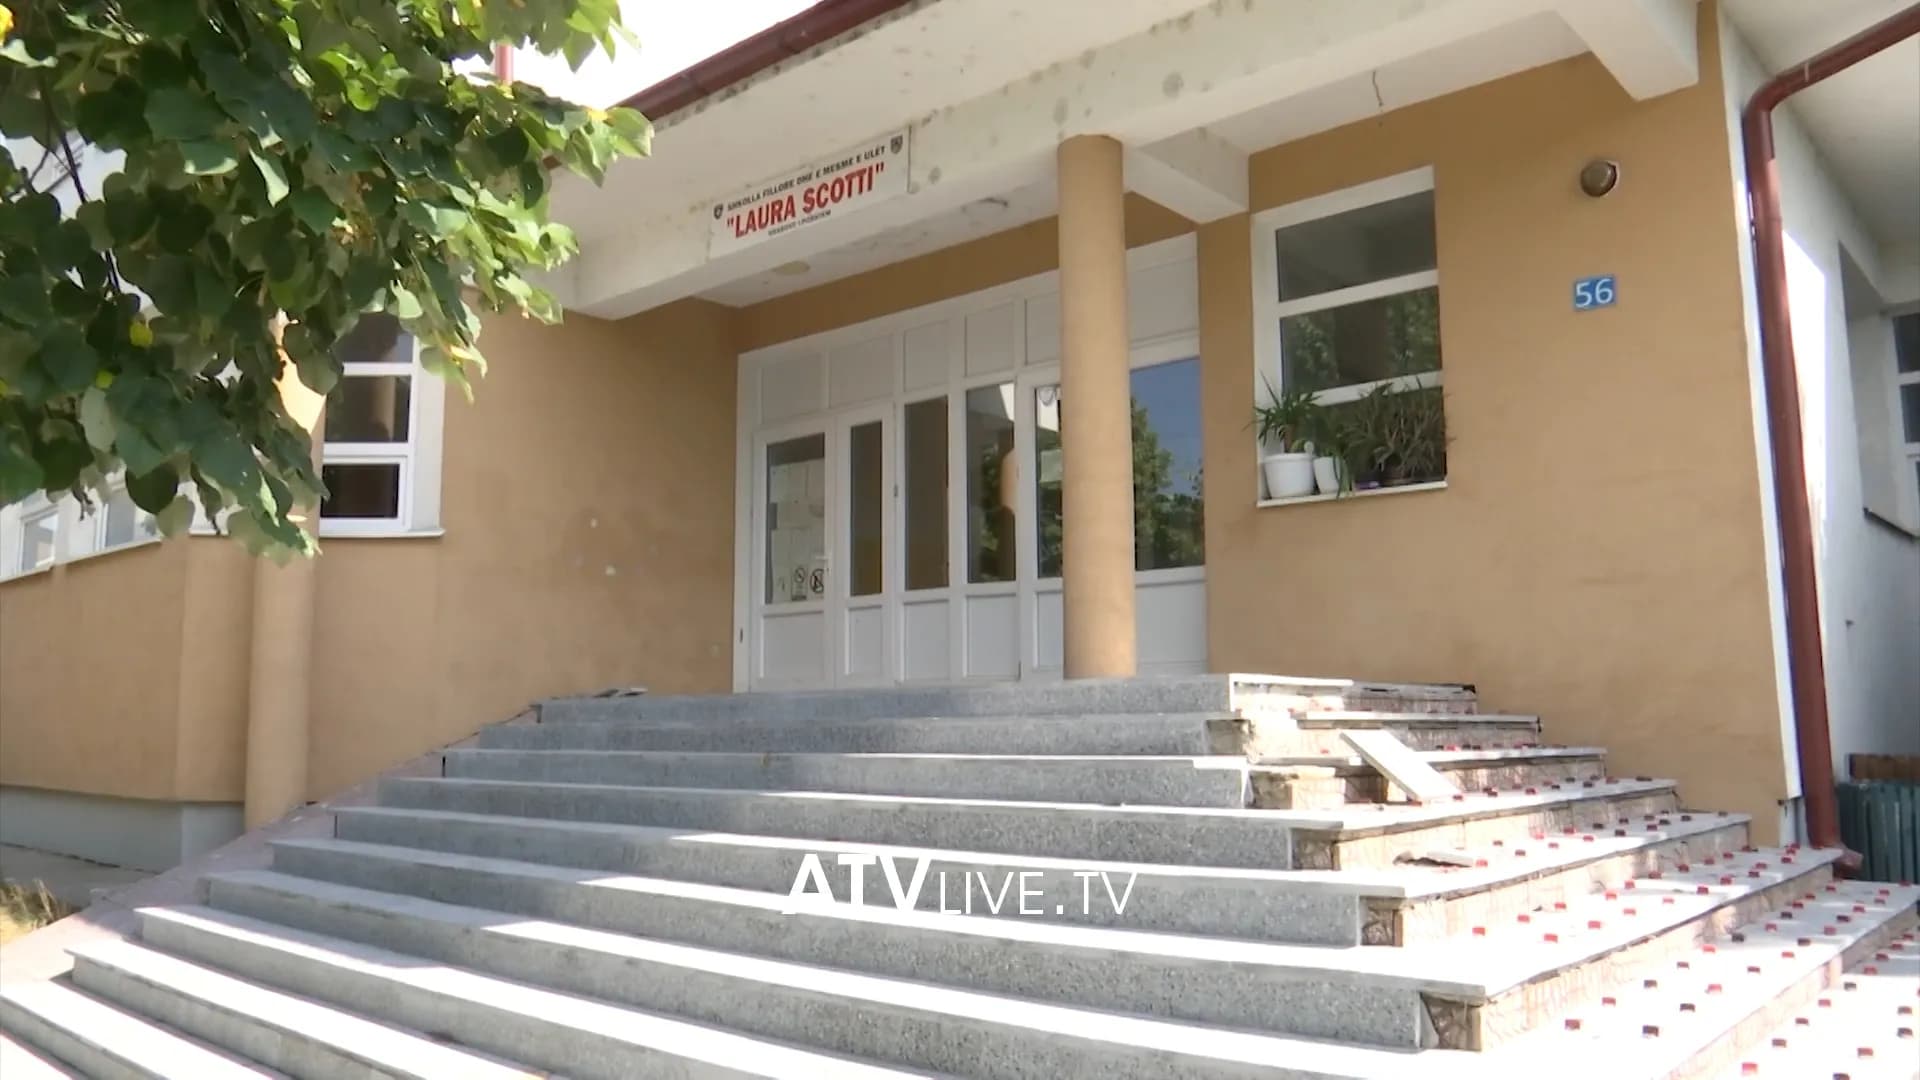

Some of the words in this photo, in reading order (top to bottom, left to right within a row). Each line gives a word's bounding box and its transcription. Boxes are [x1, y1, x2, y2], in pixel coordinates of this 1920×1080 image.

[763, 179, 795, 199] FILLORE
[796, 171, 813, 185] DHE
[823, 157, 854, 175] MESME
[727, 195, 797, 239] "LAURA
[802, 161, 885, 214] SCOTTI"
[1575, 278, 1613, 308] 56
